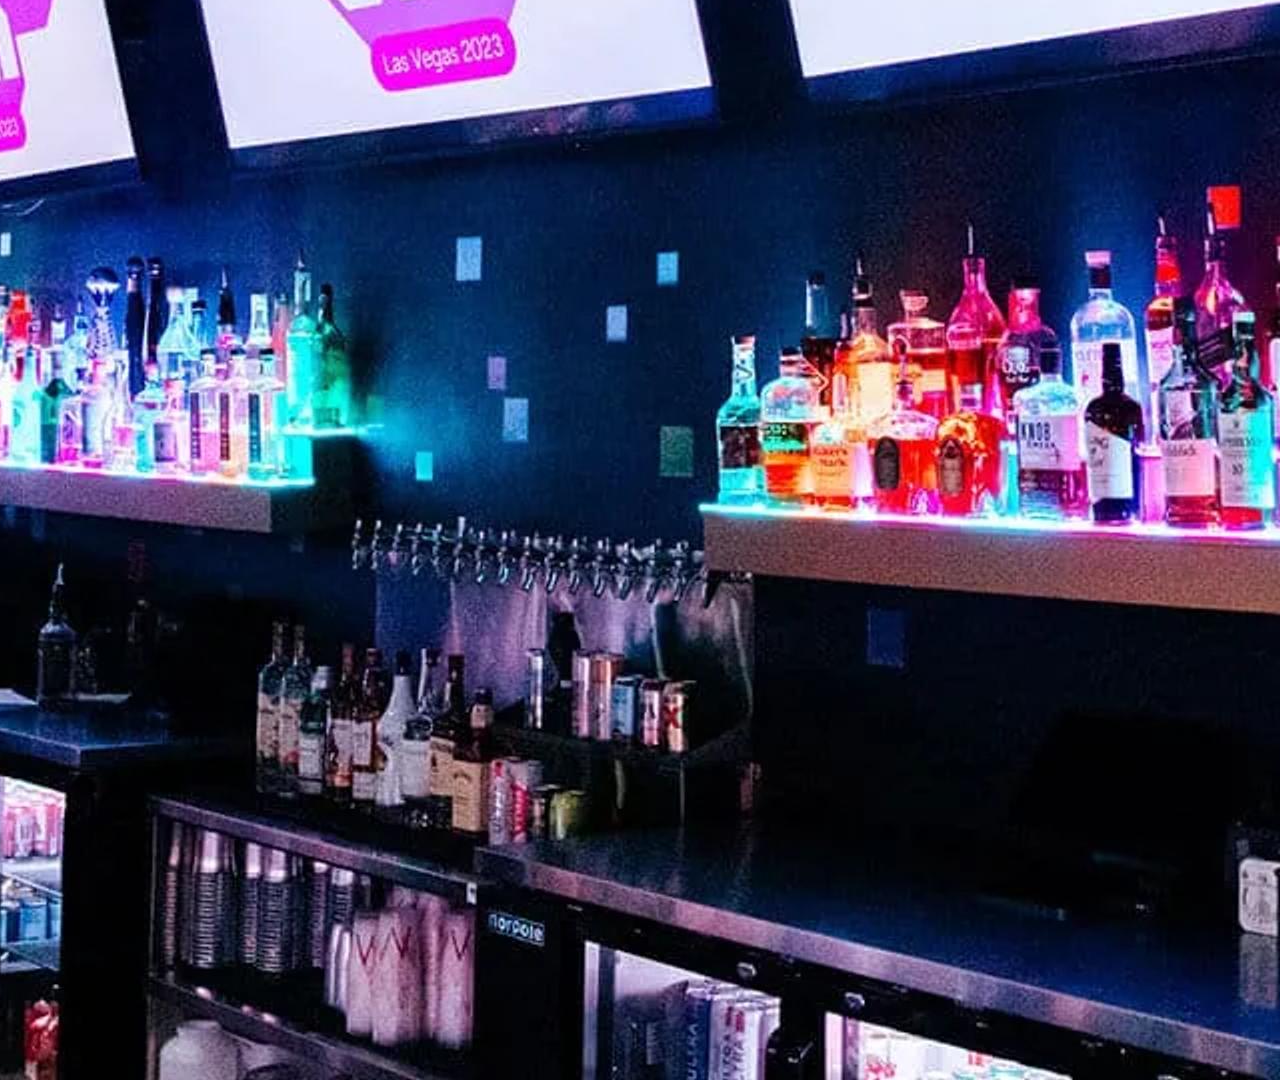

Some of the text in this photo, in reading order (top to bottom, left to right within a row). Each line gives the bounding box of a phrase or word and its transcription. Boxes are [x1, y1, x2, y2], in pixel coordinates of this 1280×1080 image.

[381, 32, 505, 76] Las Vegas 2023
